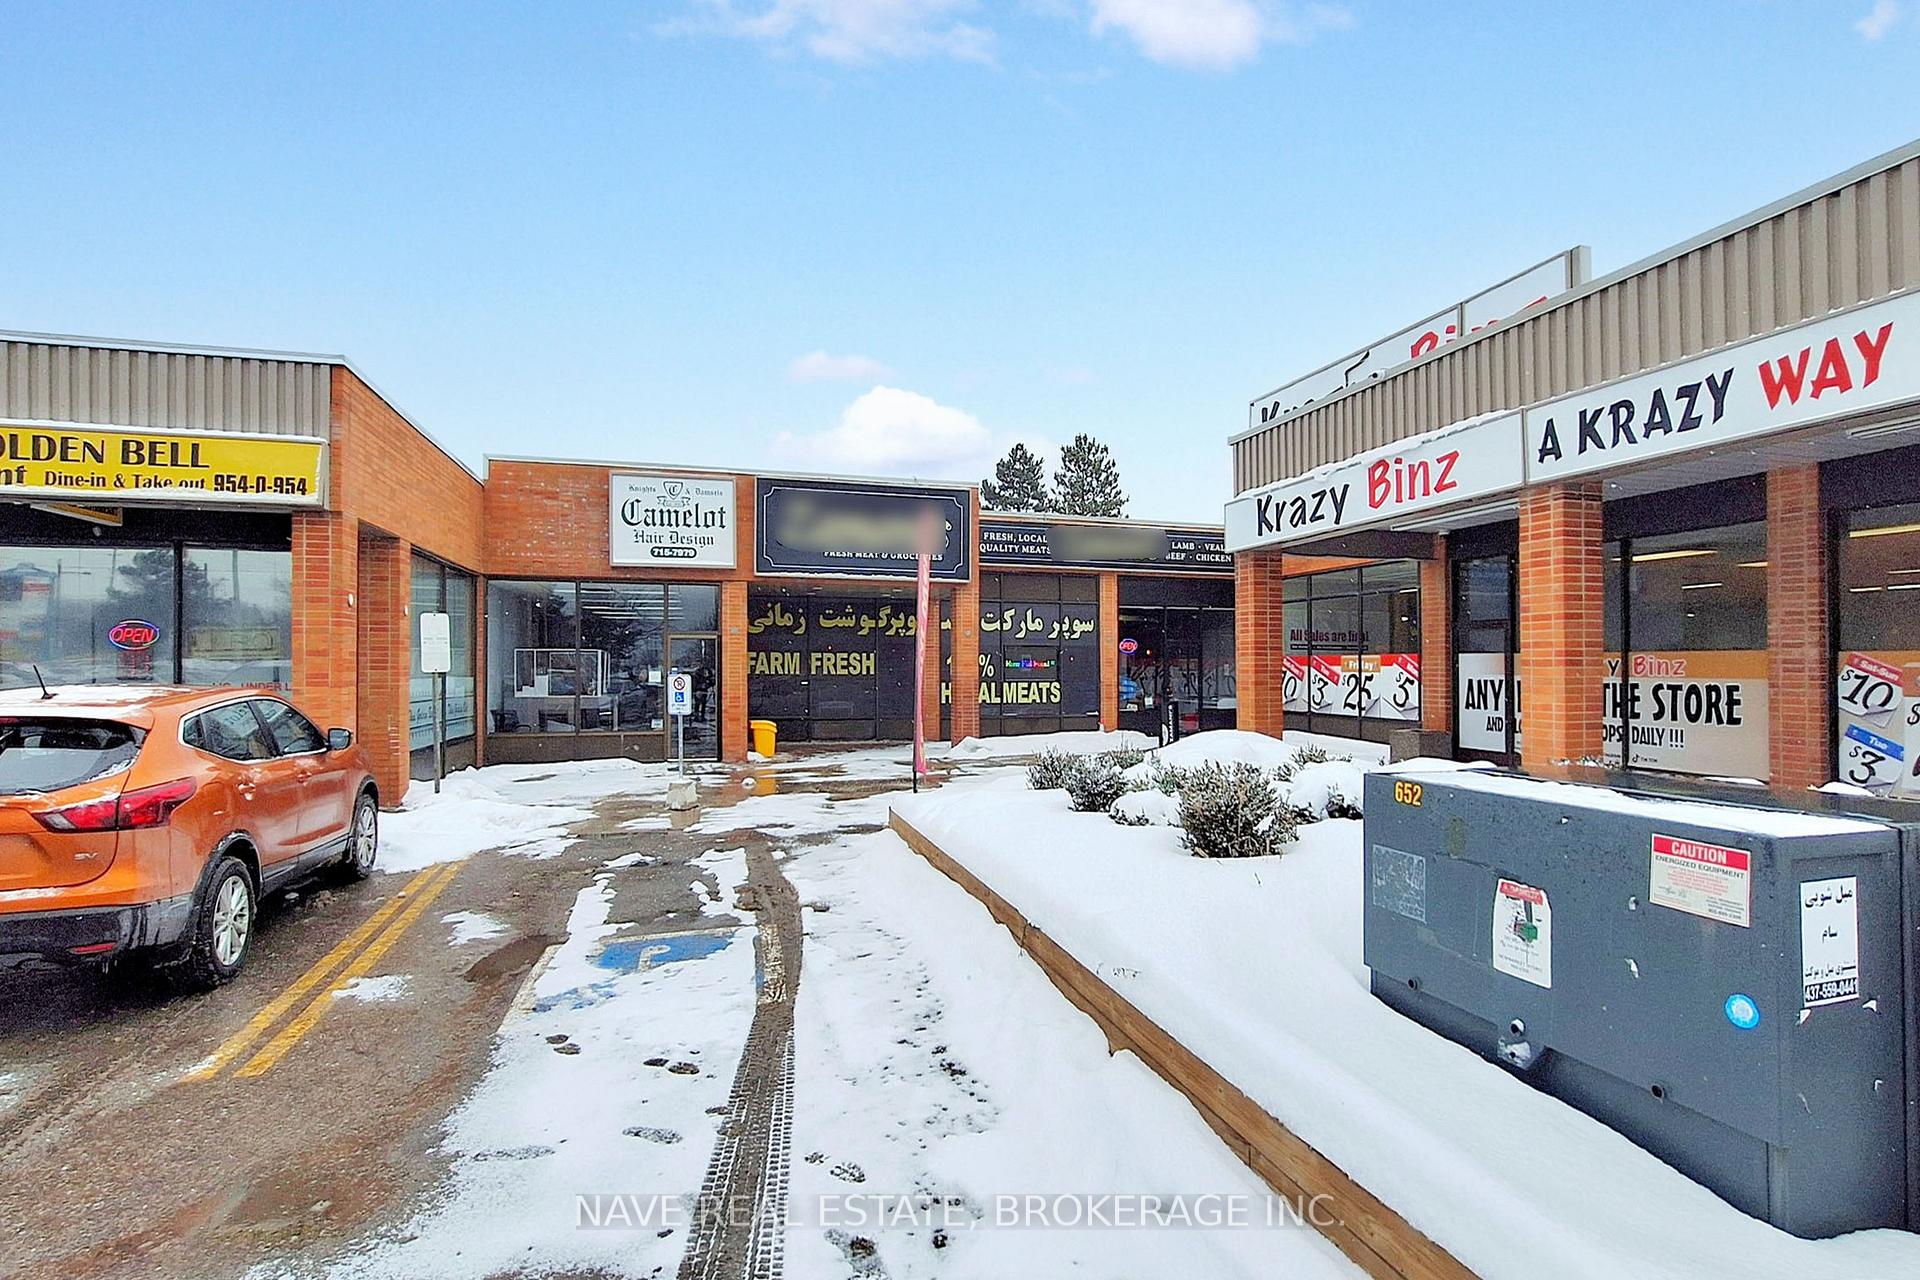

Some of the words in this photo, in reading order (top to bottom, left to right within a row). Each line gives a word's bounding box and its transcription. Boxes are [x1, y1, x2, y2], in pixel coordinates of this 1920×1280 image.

[1537, 417, 1562, 464] A
[1578, 368, 1735, 455] KRAZY
[1758, 322, 1894, 410] WAY
[0, 434, 104, 463] LDEN
[121, 439, 210, 468] BELL
[45, 471, 106, 487] Dine-in
[113, 473, 126, 488] &
[1257, 484, 1349, 536] Krazy
[1368, 451, 1460, 509] Binz
[621, 498, 726, 529] Camelot
[633, 529, 664, 544] Hair
[669, 530, 714, 548] Design
[980, 543, 1019, 553] QUALITY
[1018, 533, 1048, 543] LOCAL
[1172, 541, 1195, 550] LAMB
[1204, 543, 1225, 552] VEAL
[1195, 553, 1232, 562] CHICKEN
[112, 628, 154, 642] OPEN
[748, 652, 800, 675] FARM
[810, 652, 875, 675] FRESH
[1633, 655, 1685, 675] Binz
[1002, 682, 1061, 704] MEATS
[1465, 679, 1504, 711] ANY
[1602, 683, 1641, 719] THE
[1652, 684, 1742, 725] STORE
[1486, 716, 1503, 732] AND
[1632, 726, 1665, 746] DAILY
[1395, 781, 1422, 806] 652
[1671, 841, 1727, 865] CAUTION
[1655, 855, 1697, 870] ENERGIZED
[1698, 862, 1745, 879] EQUIPMENT
